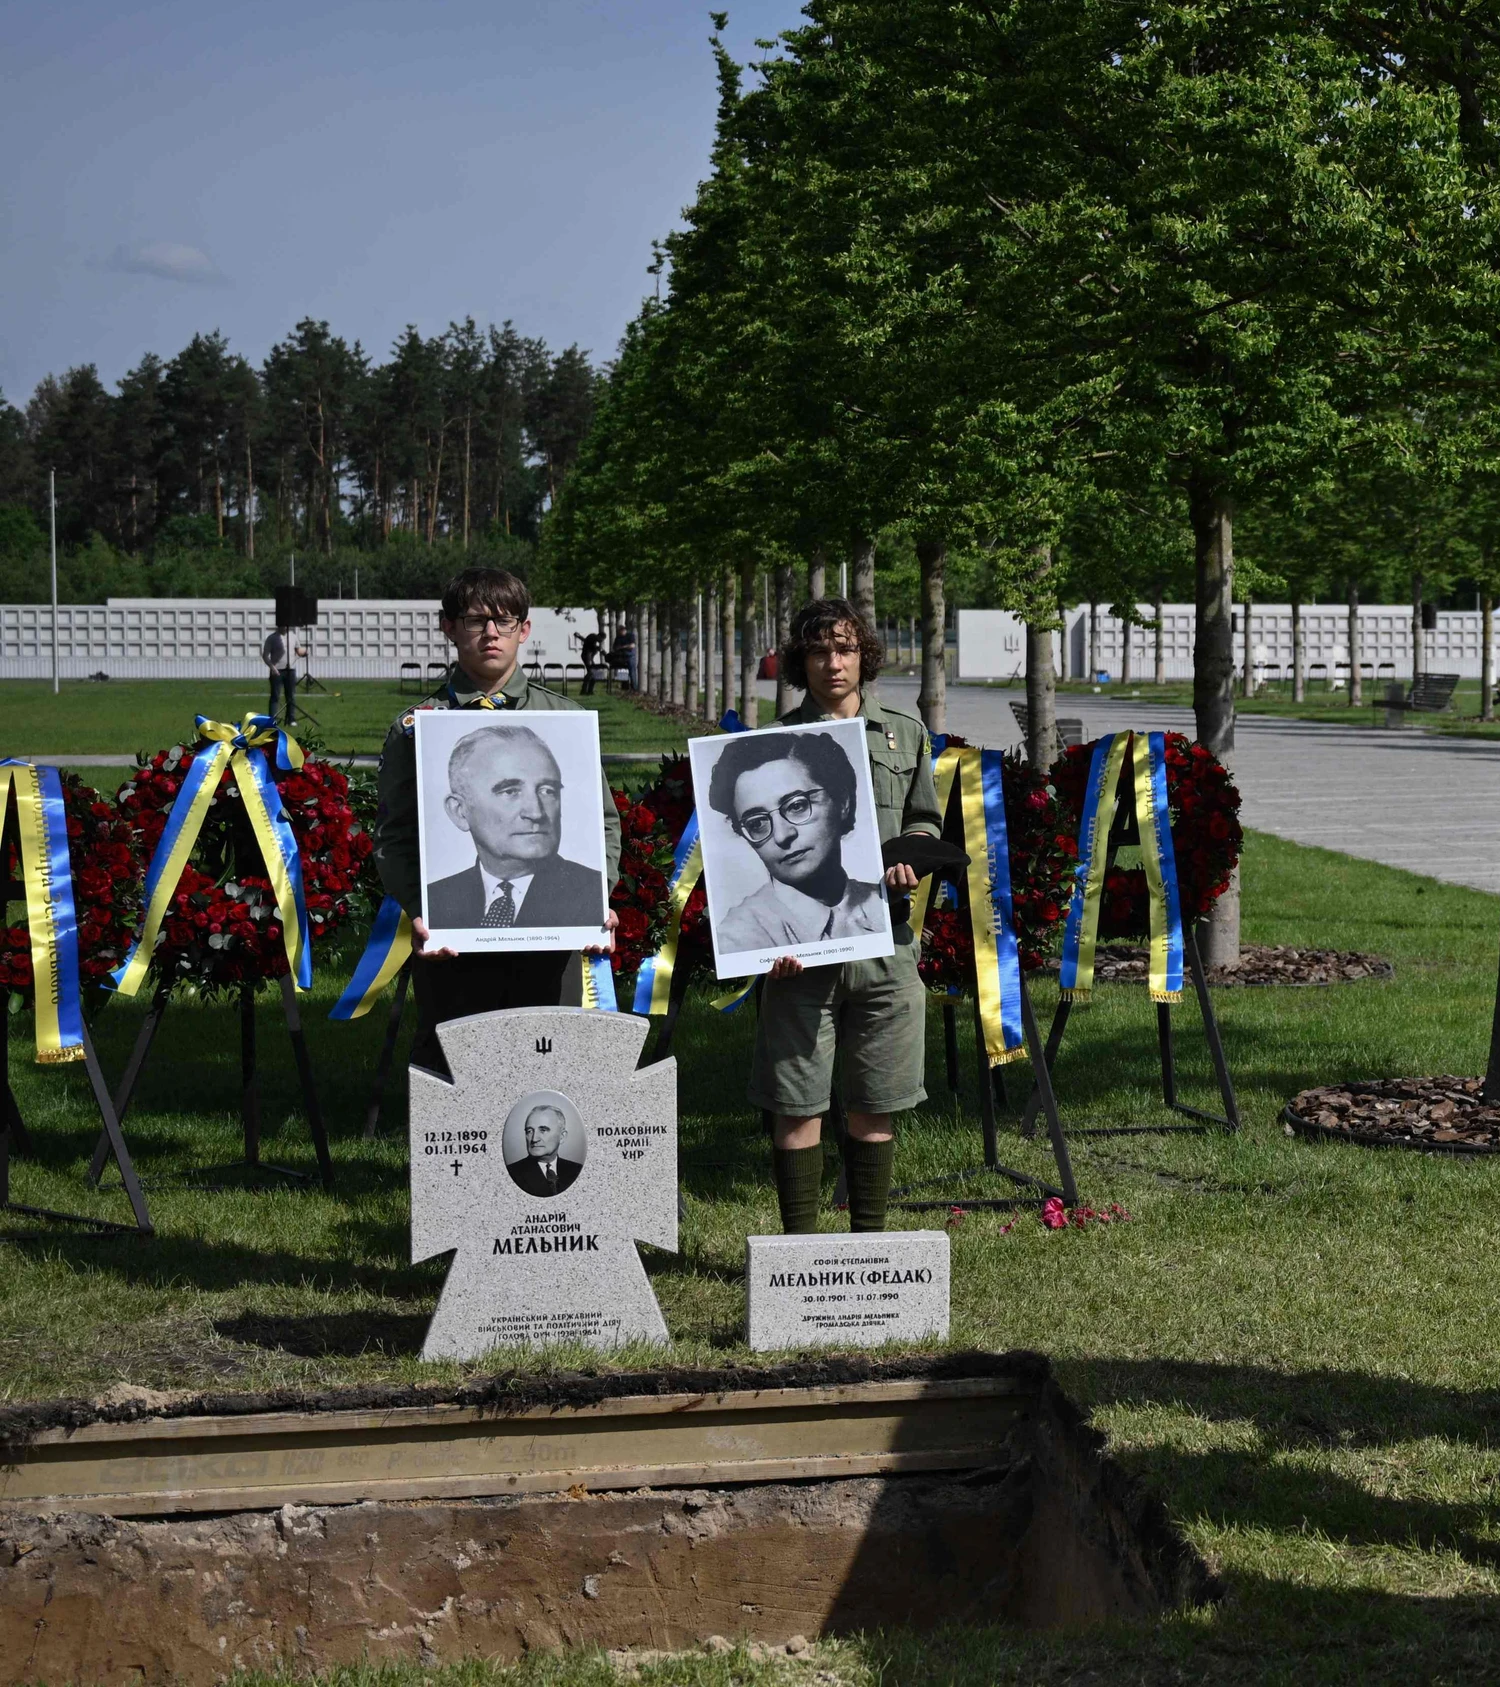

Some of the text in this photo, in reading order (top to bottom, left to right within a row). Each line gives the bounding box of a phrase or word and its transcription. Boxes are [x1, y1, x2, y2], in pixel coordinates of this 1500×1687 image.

[28, 768, 64, 1005] Володимира Зеленського
[980, 843, 1004, 936] УКРАЇНИ
[424, 1130, 488, 1142] 12.12.1890
[597, 1125, 667, 1136] ПОЛКОВНИК
[425, 1143, 487, 1155] 01.11.1964
[622, 1150, 644, 1160] УНР
[525, 1212, 566, 1224] АНДРІЙ
[510, 1223, 581, 1235] АТАНАСОВИЧ
[492, 1234, 599, 1255] МЕЛЬНИК
[840, 1257, 890, 1266] СТЕПАНІВНА
[769, 1268, 932, 1287] МЕЛЬНИК (ФЕДАК)
[803, 1294, 846, 1303] 30.10.1901
[491, 1311, 603, 1324] УКРАЇНСЬКИЙ ДЕРЖАВНИЙ
[801, 1315, 836, 1323] ДРУЖИНА
[837, 1313, 862, 1321] АНДРІЯ
[477, 1323, 531, 1333] ВІЙСЬКОВИЙ
